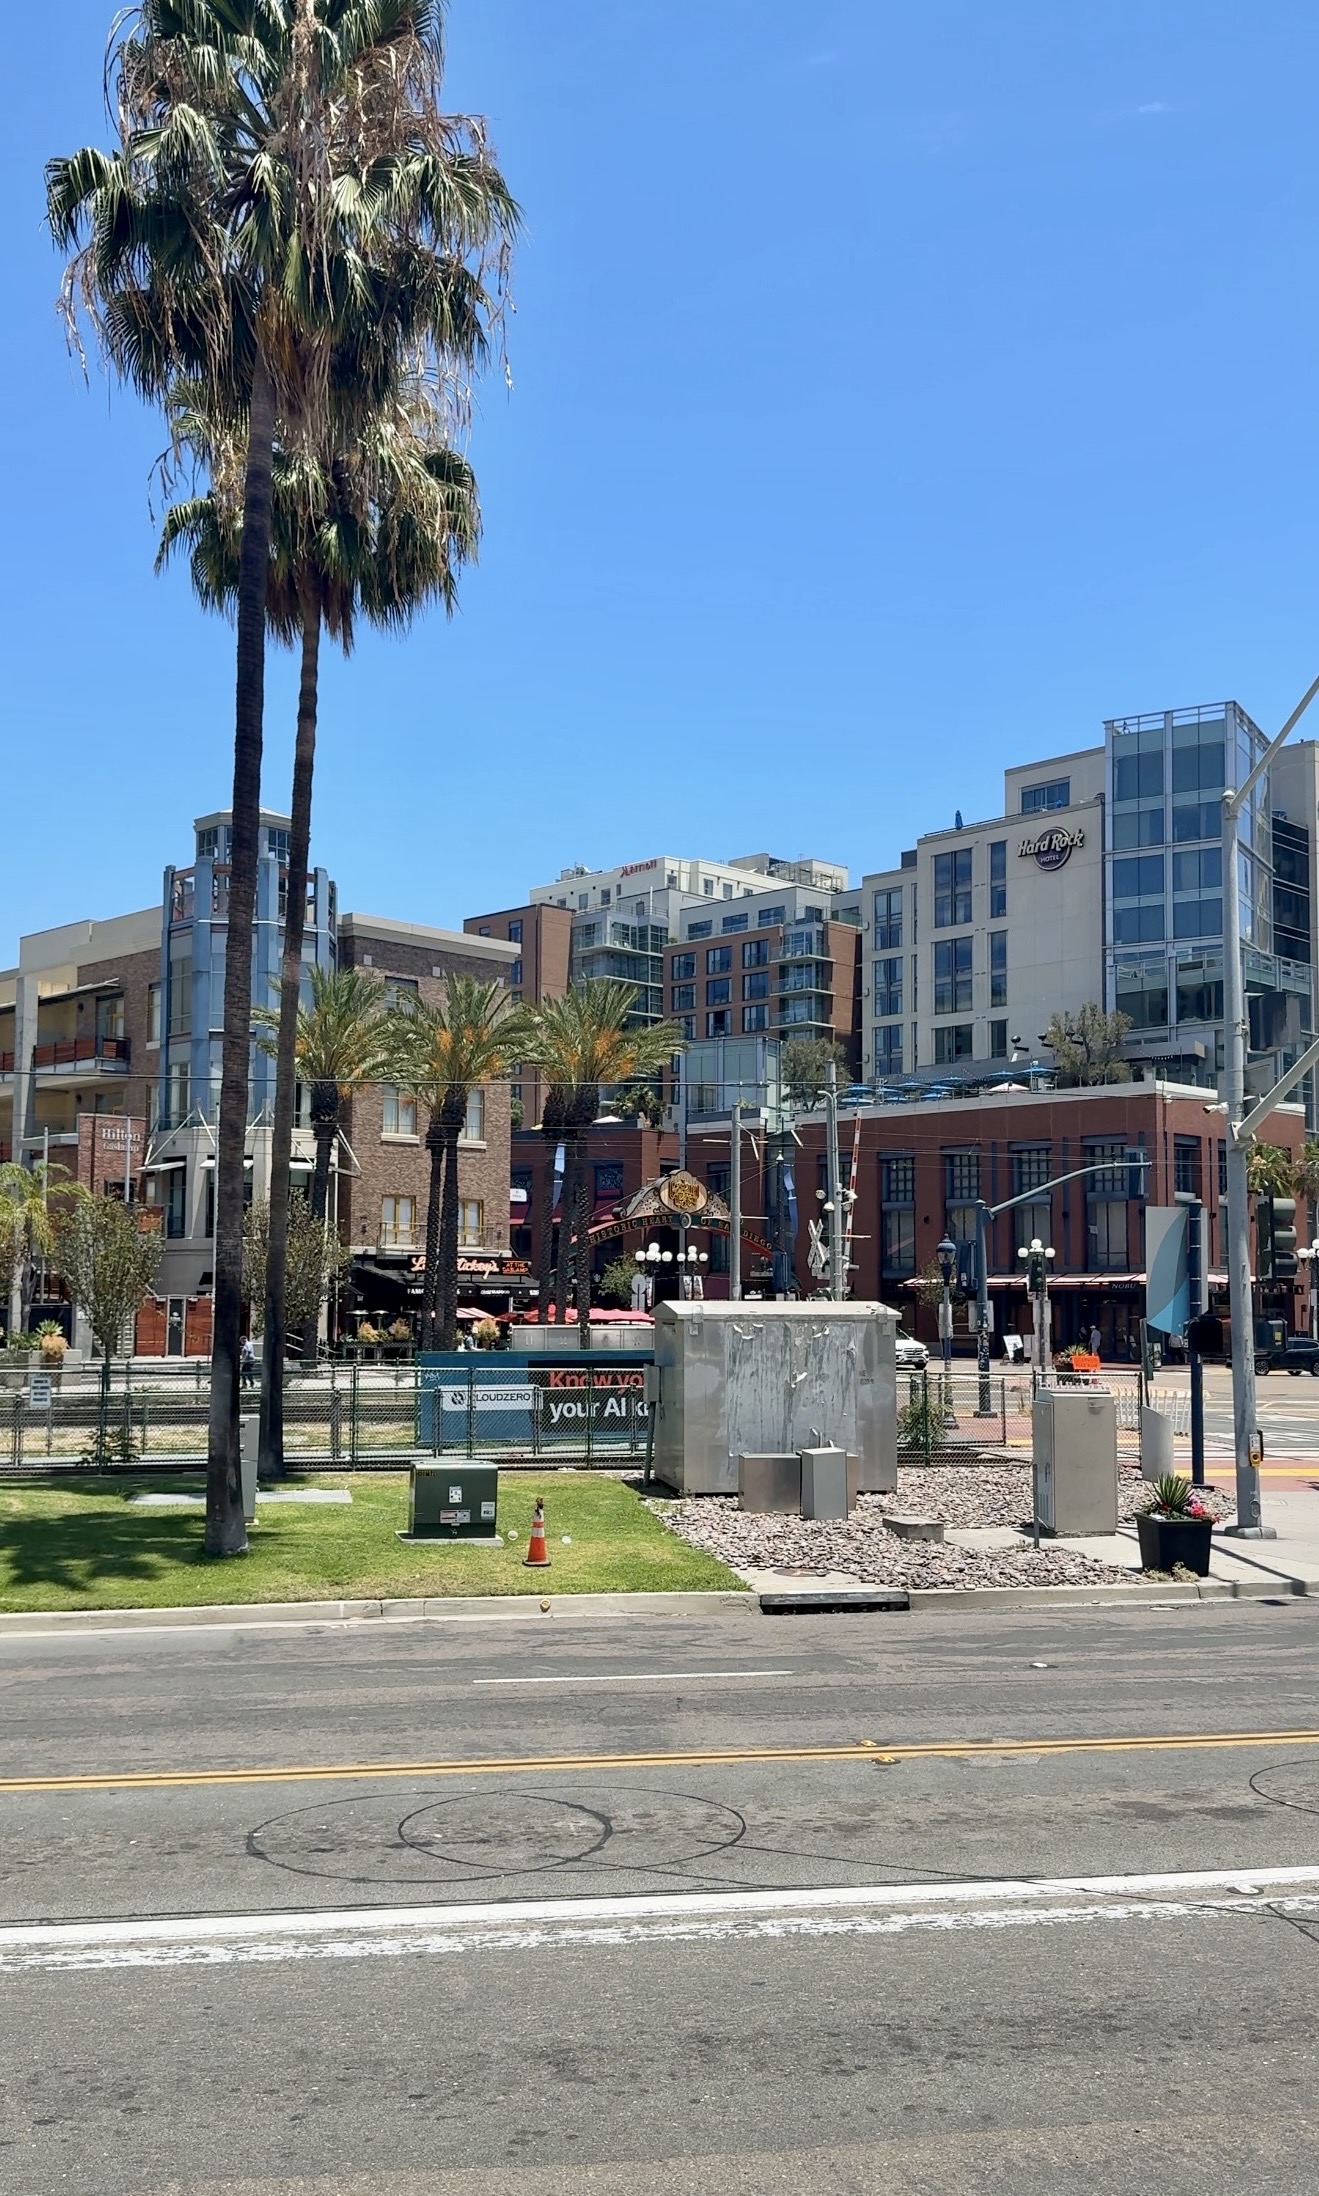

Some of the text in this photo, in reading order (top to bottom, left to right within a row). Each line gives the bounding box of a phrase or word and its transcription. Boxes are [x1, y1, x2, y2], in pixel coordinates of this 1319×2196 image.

[1018, 829, 1084, 857] Hard Rock
[1040, 854, 1060, 863] HOTEL
[102, 1128, 141, 1142] Hilton
[589, 1220, 638, 1244] HISTORIC
[642, 1215, 673, 1226] HEART
[701, 1217, 712, 1226] OF
[742, 1229, 773, 1250] DIEGO
[550, 1371, 643, 1395] Know yo
[468, 1392, 531, 1402] LOUDZERO
[550, 1402, 600, 1424] your
[603, 1397, 626, 1417] AI
